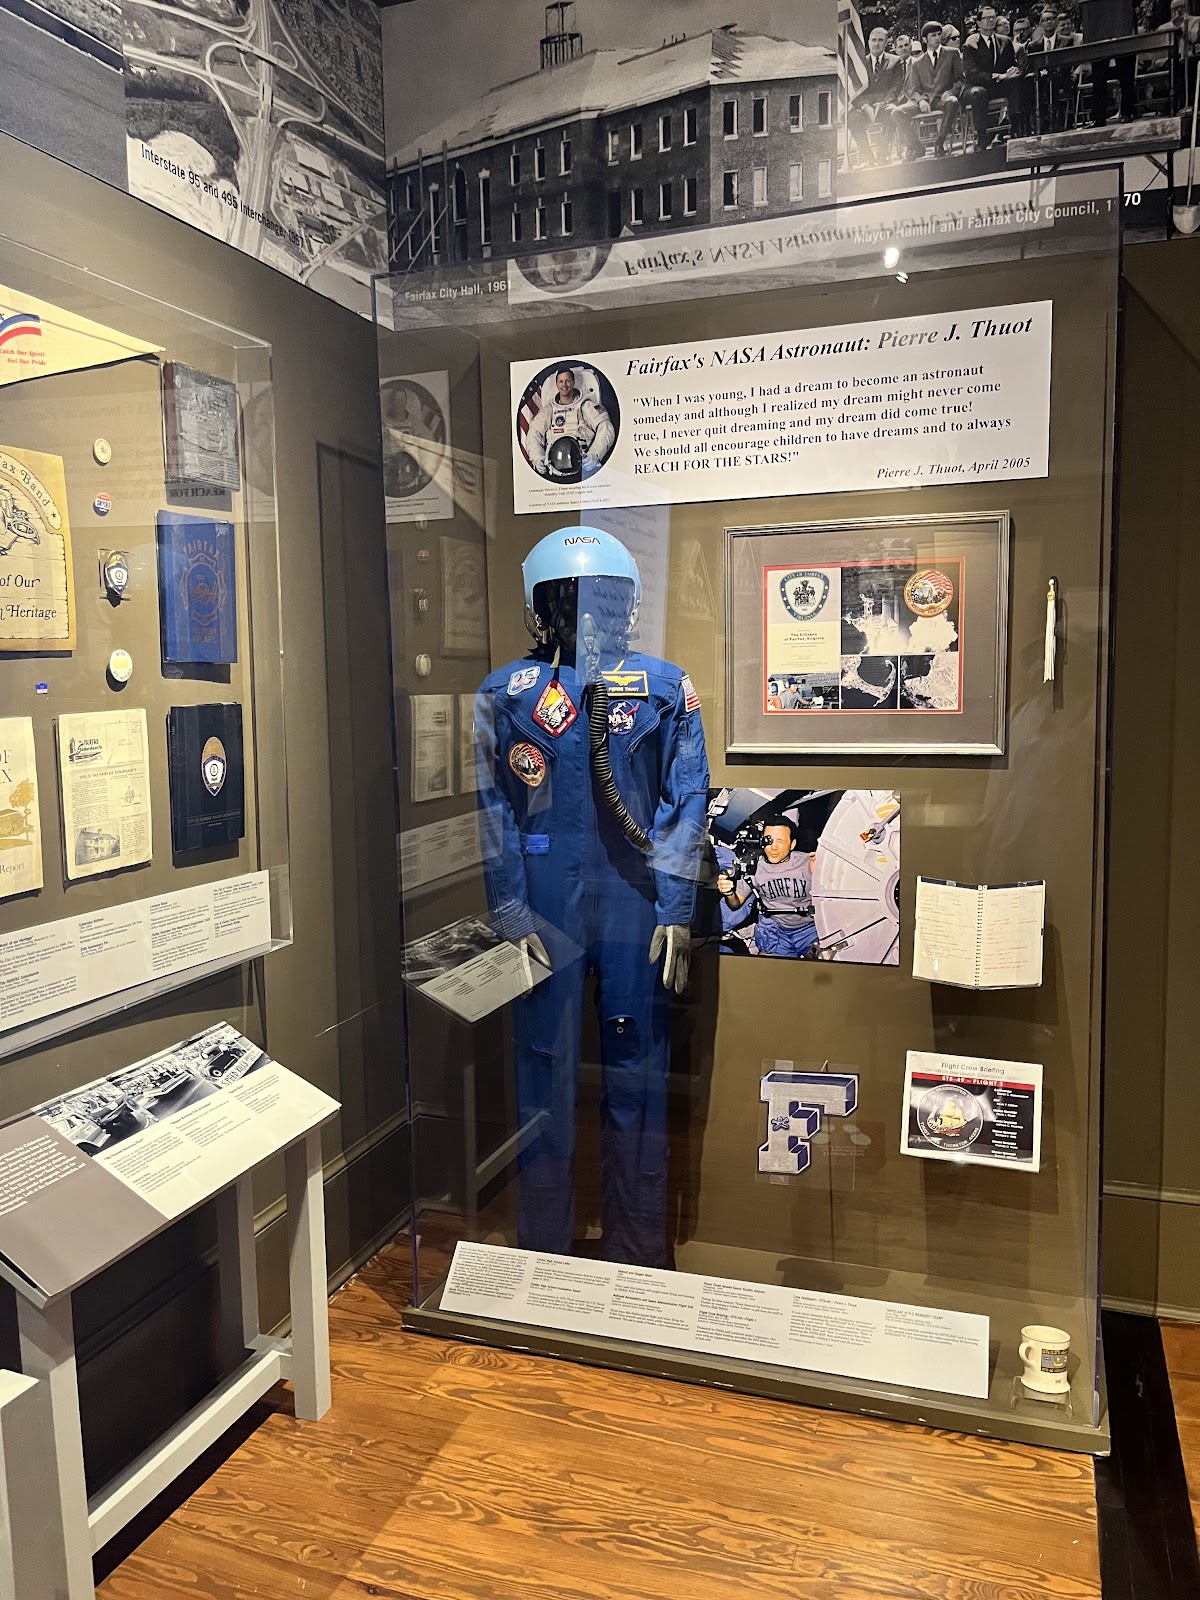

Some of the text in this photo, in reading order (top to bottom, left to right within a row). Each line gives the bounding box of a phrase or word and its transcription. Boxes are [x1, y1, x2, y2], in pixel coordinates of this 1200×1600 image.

[142, 144, 185, 179] Interstate
[188, 171, 200, 188] 95
[204, 181, 219, 198] and
[222, 190, 238, 209] 495
[240, 200, 285, 238] Interchange,
[854, 230, 892, 245] Mayor
[940, 218, 963, 233] and
[968, 213, 1011, 230] Fairfax
[1016, 207, 1041, 224] City
[1045, 202, 1099, 220] Council,
[1106, 192, 1141, 212] 170
[405, 291, 437, 302] Fairfax
[440, 287, 458, 300] City
[460, 284, 483, 296] Hall,
[625, 317, 1033, 378] Fairfax's NASA Astronaut: Pierre J. Thuot
[633, 364, 984, 407] "When I was young, I had a dream to become an astronaut
[633, 382, 1001, 426] someday and although I realized my dream might never come
[633, 400, 972, 442] true, I never quit dreaming and my dream did come true!
[633, 418, 1011, 458] We should all encourage children to have dreams and to always
[634, 451, 799, 475] REACH FOR THE STARS!"
[876, 457, 1031, 478] Pierre J. Thuot, April 2005
[21, 469, 50, 507] Band
[564, 537, 601, 546] NASA
[14, 575, 41, 588] Our
[6, 605, 57, 620] Heritage
[0, 862, 24, 874] Report
[760, 877, 807, 899] FAIRFAX
[980, 1066, 1005, 1075] Briefing
